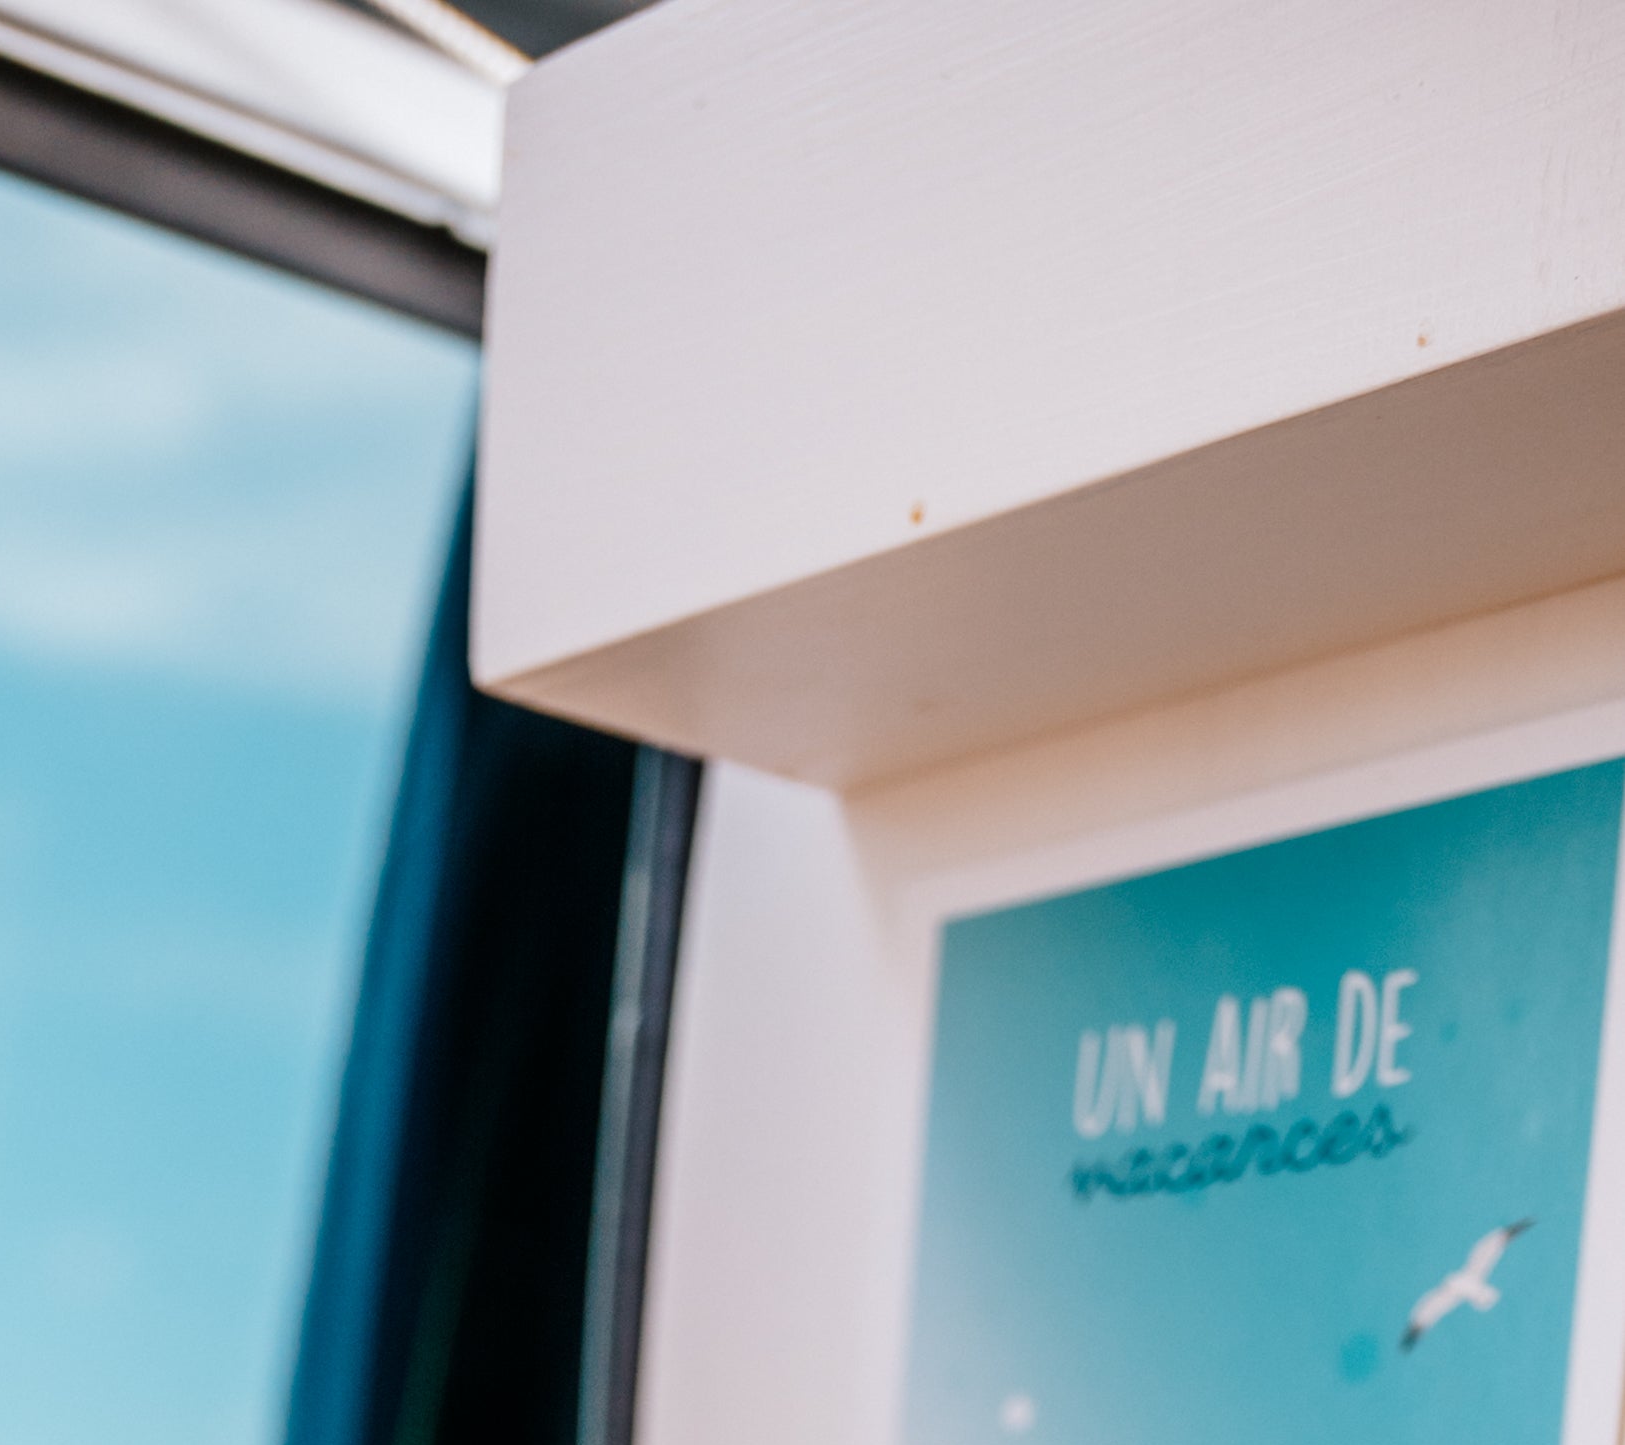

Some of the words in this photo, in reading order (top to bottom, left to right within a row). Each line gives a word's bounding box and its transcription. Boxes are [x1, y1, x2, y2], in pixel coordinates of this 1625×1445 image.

[1074, 1018, 1176, 1138] UN
[1198, 985, 1308, 1115] AIR
[1332, 968, 1418, 1097] DE
[1070, 1102, 1414, 1200] vacances
